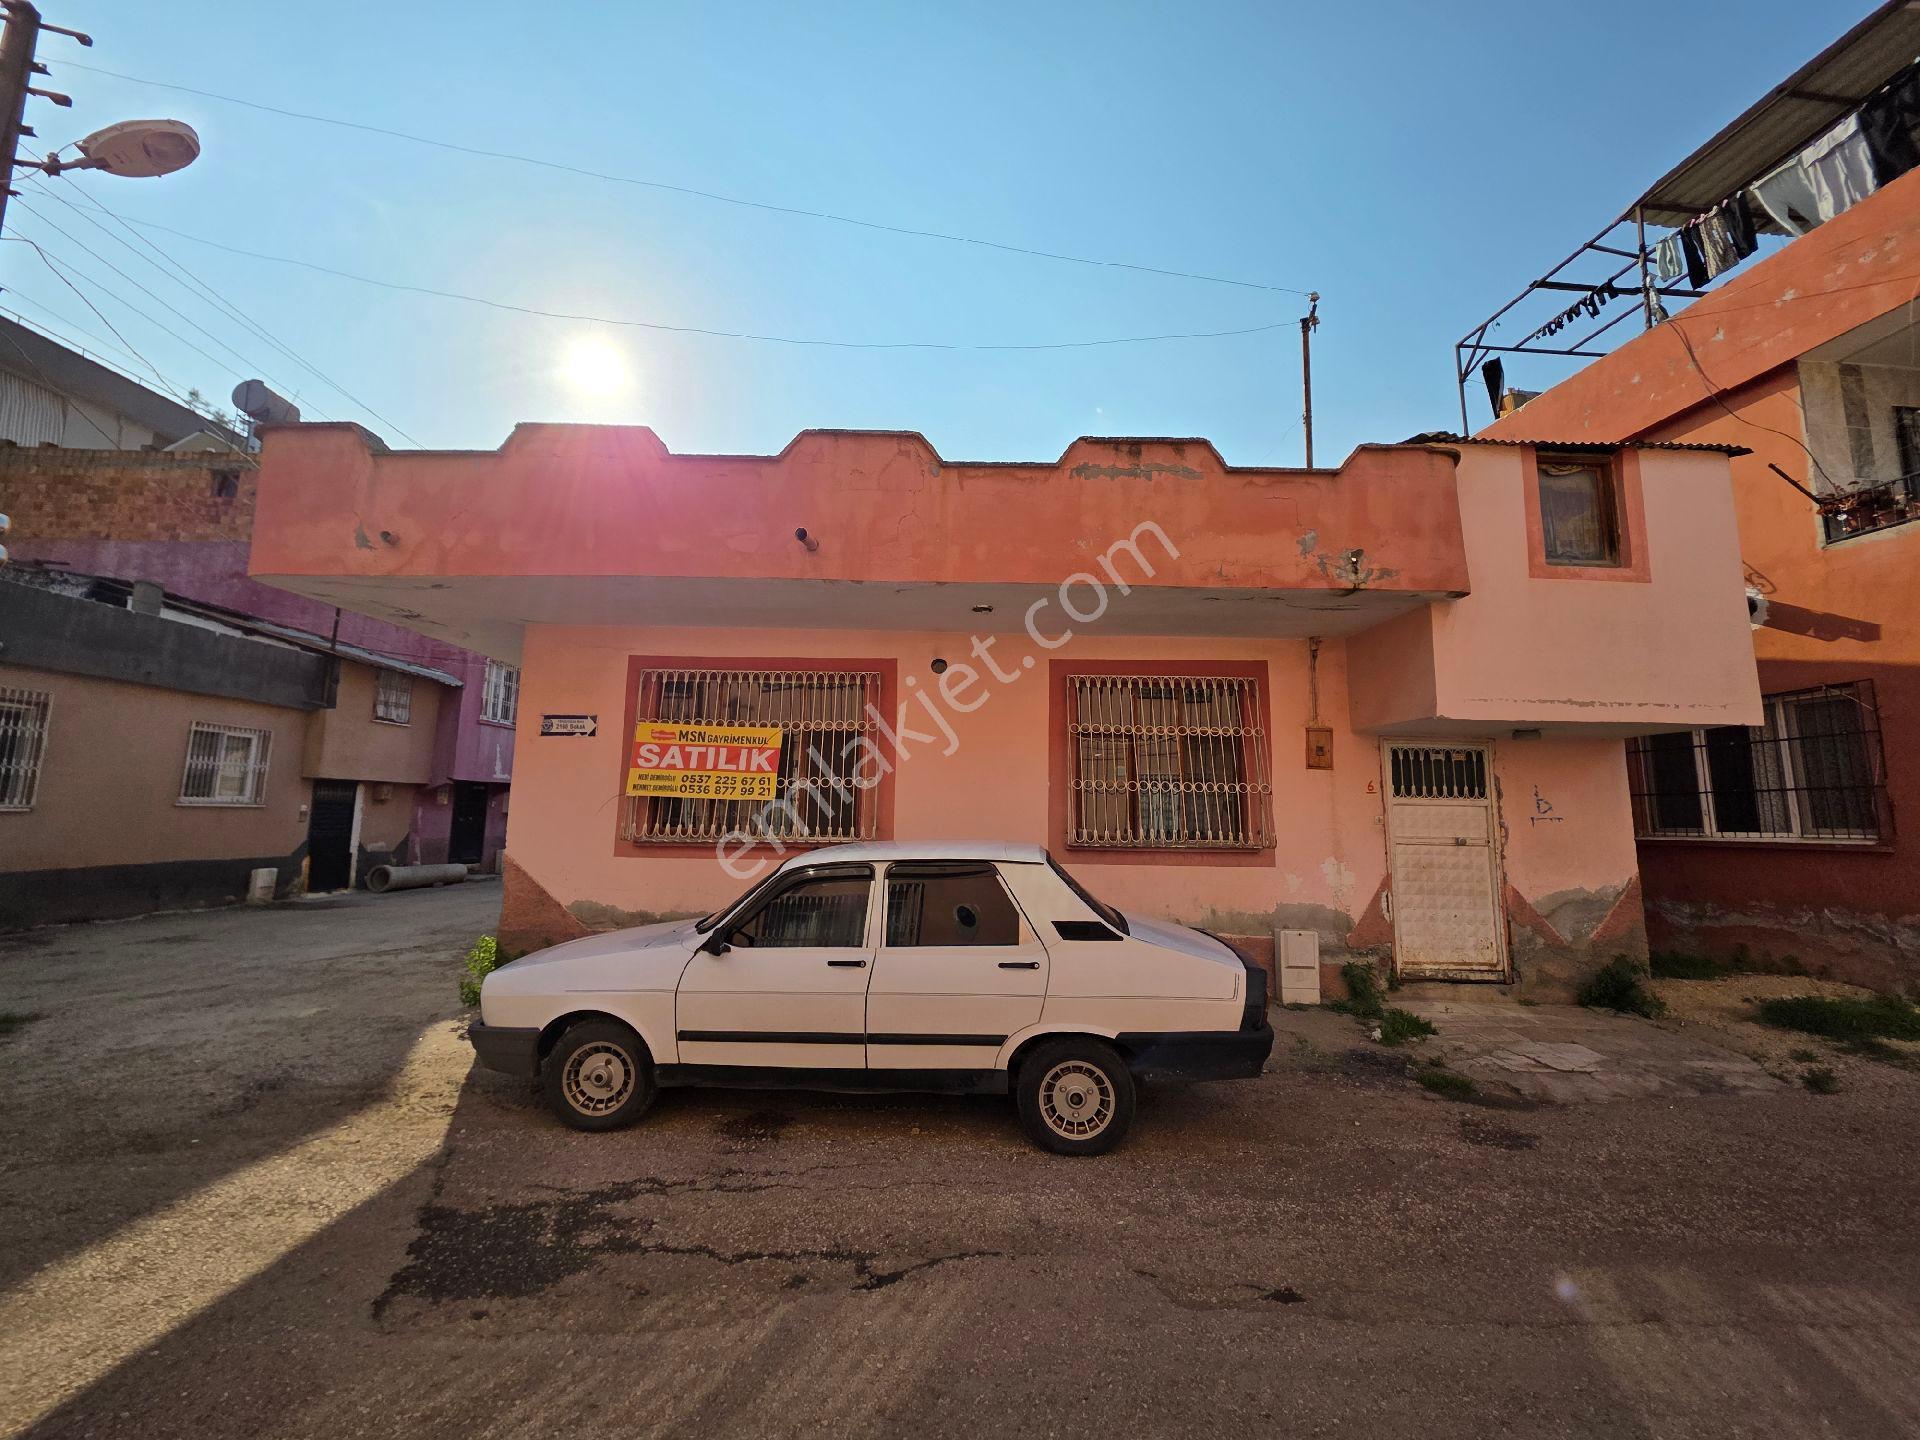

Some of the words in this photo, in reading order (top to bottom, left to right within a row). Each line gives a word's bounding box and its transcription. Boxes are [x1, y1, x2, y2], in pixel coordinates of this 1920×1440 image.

[678, 729, 707, 743] MSN
[707, 733, 769, 745] GAYRİMENKUL
[637, 743, 776, 772] SATILIK
[681, 774, 712, 784] 0537
[715, 775, 737, 786] 225
[740, 776, 756, 786] 67
[758, 776, 771, 787] 61
[1366, 779, 1375, 792] 6
[679, 783, 711, 795] 0536
[714, 785, 737, 796] 877
[740, 786, 755, 796] 99
[757, 786, 771, 797] 21
